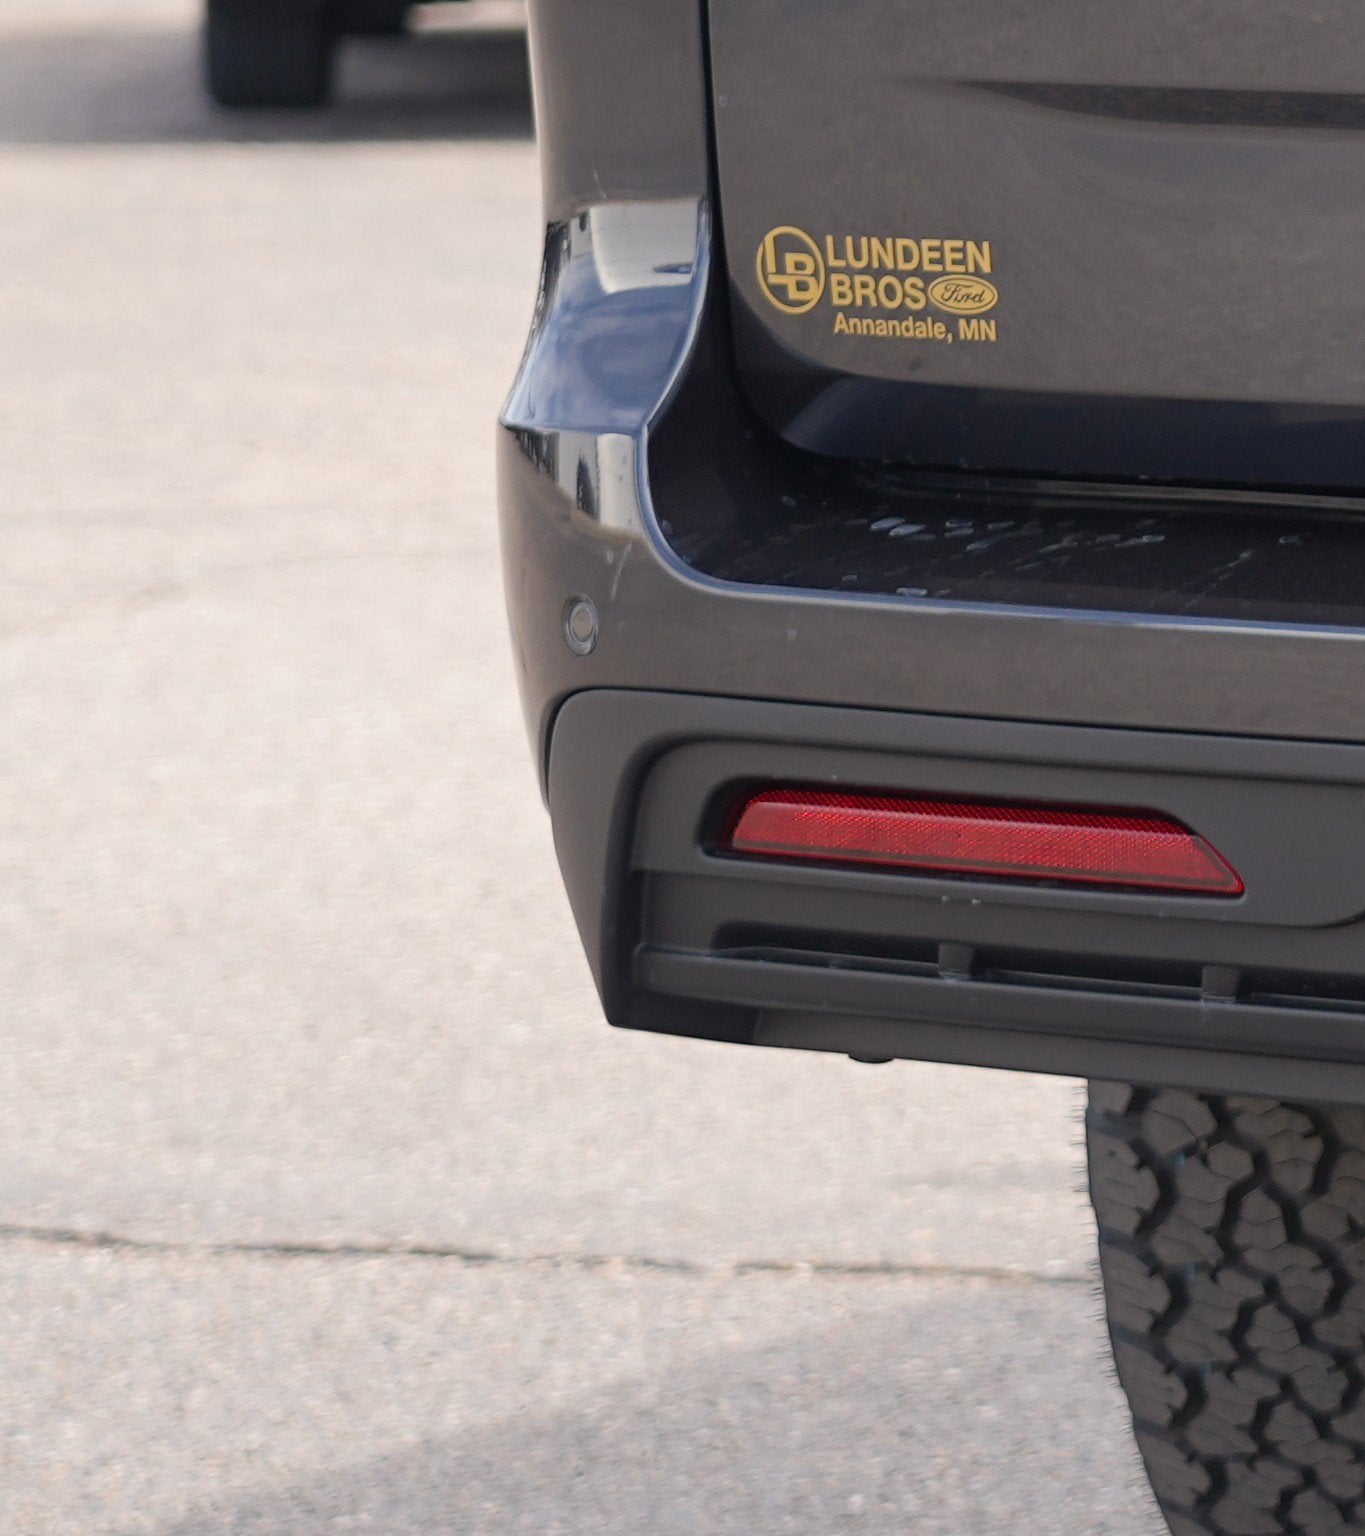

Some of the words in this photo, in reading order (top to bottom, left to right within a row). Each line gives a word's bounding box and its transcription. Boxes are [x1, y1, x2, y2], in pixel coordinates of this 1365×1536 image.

[825, 234, 992, 274] LUNDEEN
[830, 272, 928, 311] BROS
[833, 312, 953, 344] Annandale,
[959, 317, 998, 342] MN
